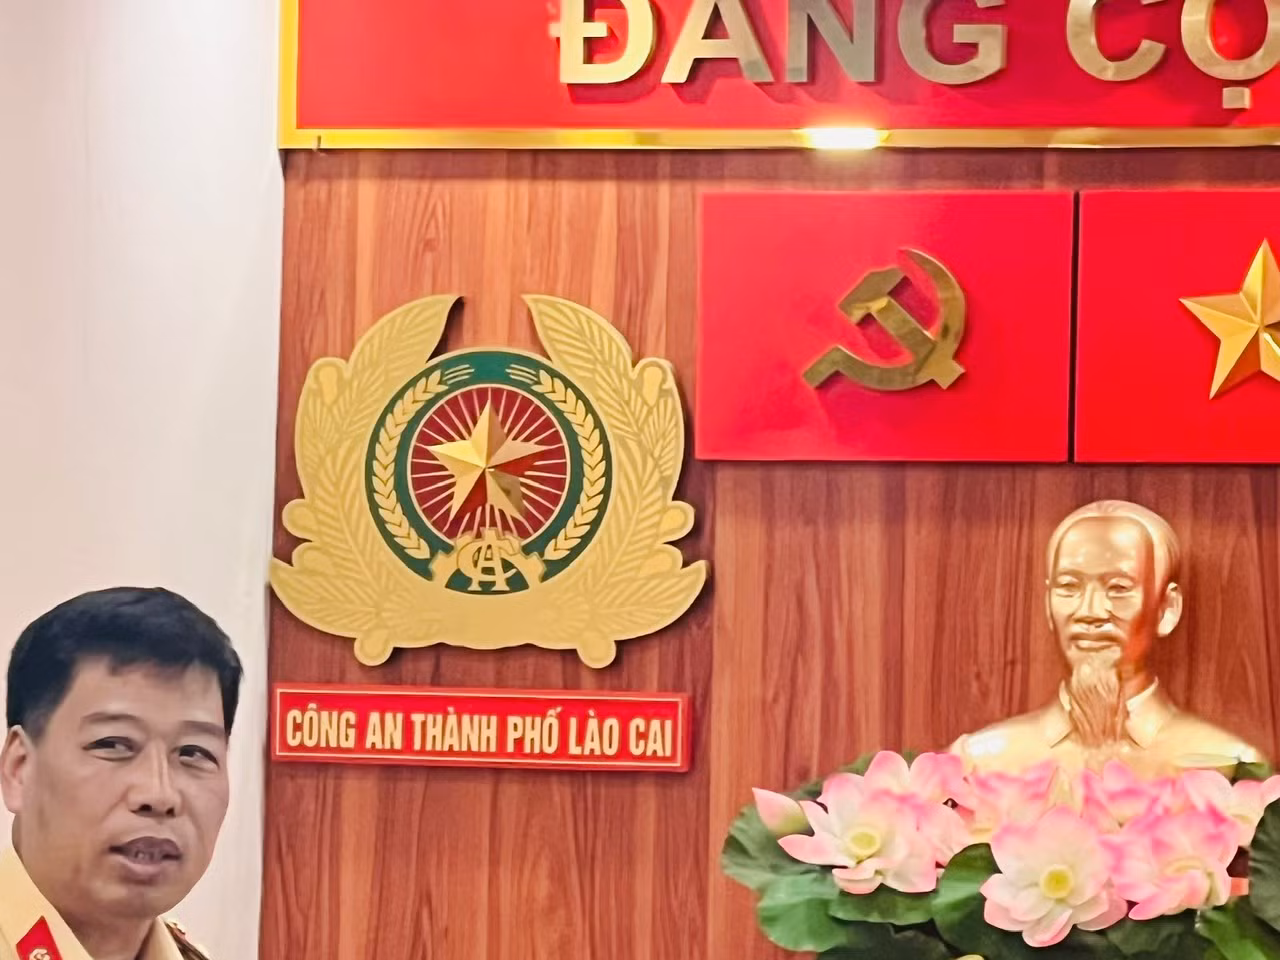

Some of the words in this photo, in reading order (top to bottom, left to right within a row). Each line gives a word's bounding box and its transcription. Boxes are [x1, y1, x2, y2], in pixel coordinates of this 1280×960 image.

[286, 702, 356, 748] CÔNG
[365, 711, 404, 750] AN
[411, 706, 497, 753] THÀNH
[506, 706, 564, 755] PHỐ
[568, 709, 619, 756] LÀO
[629, 717, 672, 757] CAI
